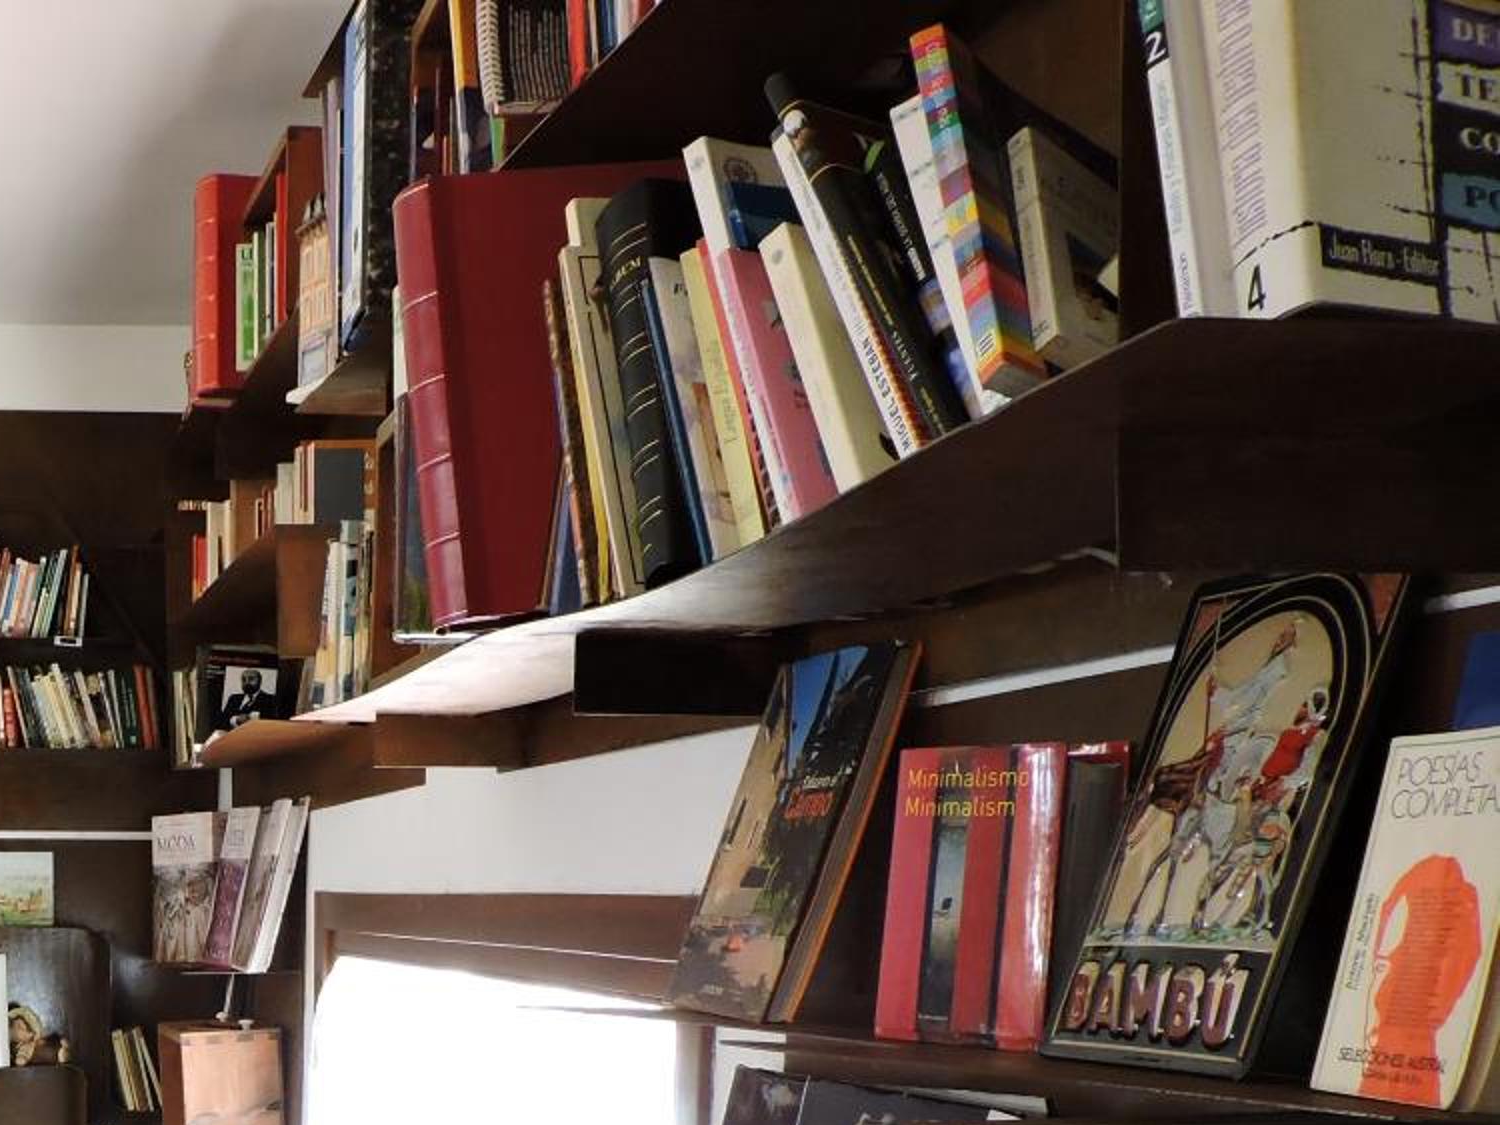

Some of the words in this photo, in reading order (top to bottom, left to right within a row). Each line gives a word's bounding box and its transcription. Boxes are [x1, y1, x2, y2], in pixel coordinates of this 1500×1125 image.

[1145, 31, 1167, 64] 2
[1247, 264, 1266, 311] 4
[859, 335, 891, 398] ESTEBAN
[884, 397, 913, 452] MIGUEL
[907, 764, 1030, 790] Minimalismo
[904, 797, 1016, 818] Minimalism
[1064, 952, 1250, 1049] BAMBÚ
